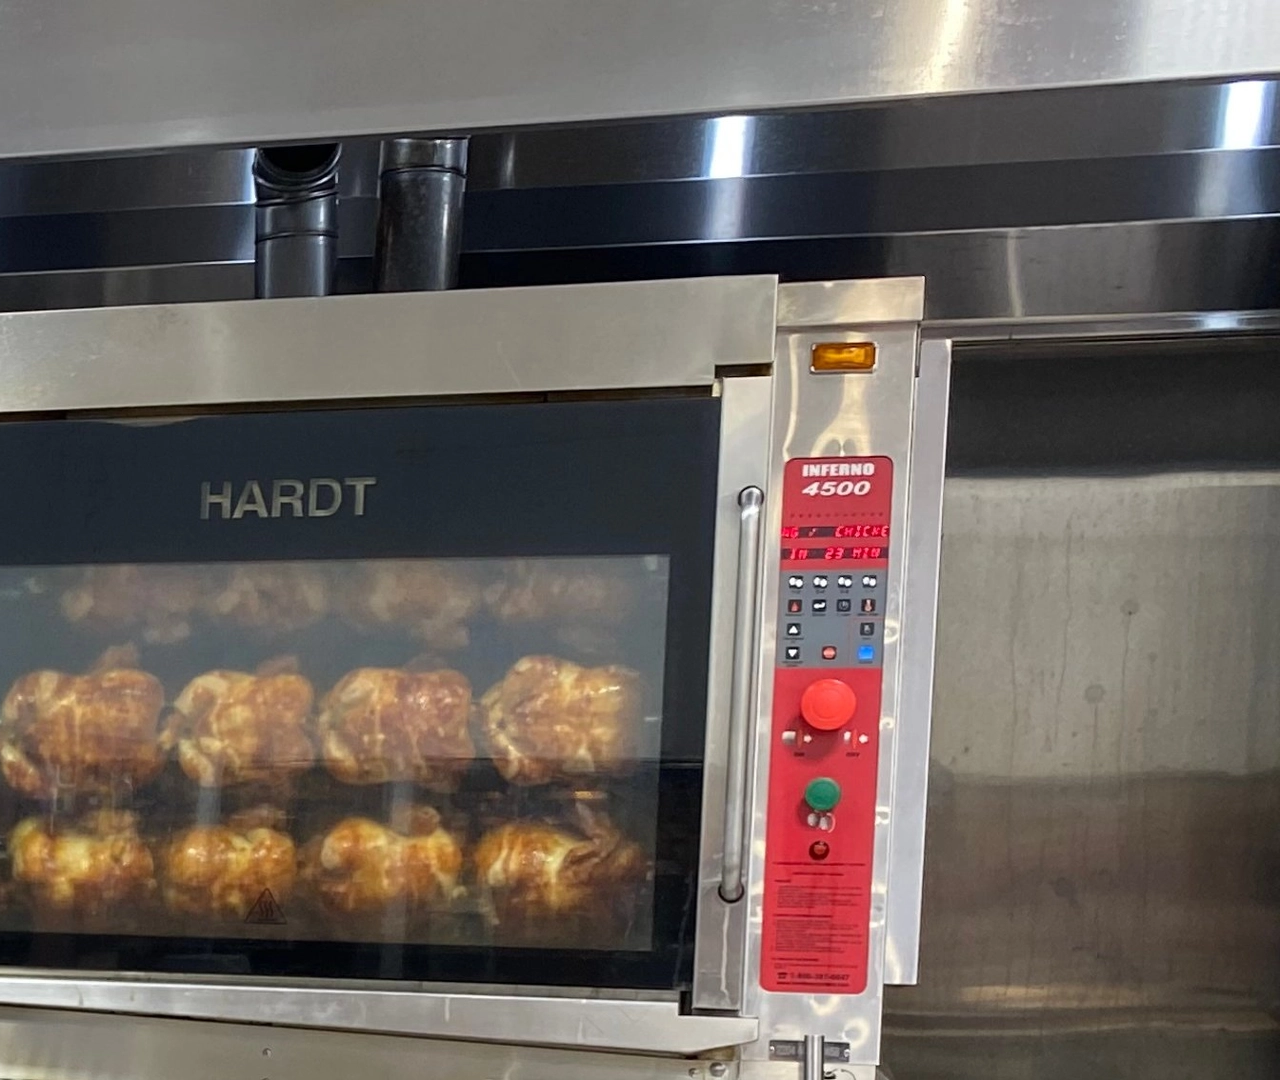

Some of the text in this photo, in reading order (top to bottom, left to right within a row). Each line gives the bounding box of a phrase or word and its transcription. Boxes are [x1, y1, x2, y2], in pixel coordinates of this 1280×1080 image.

[802, 463, 875, 477] INFERNO
[801, 480, 871, 496] 4500
[200, 477, 377, 519] HARDT
[824, 548, 845, 560] 23
